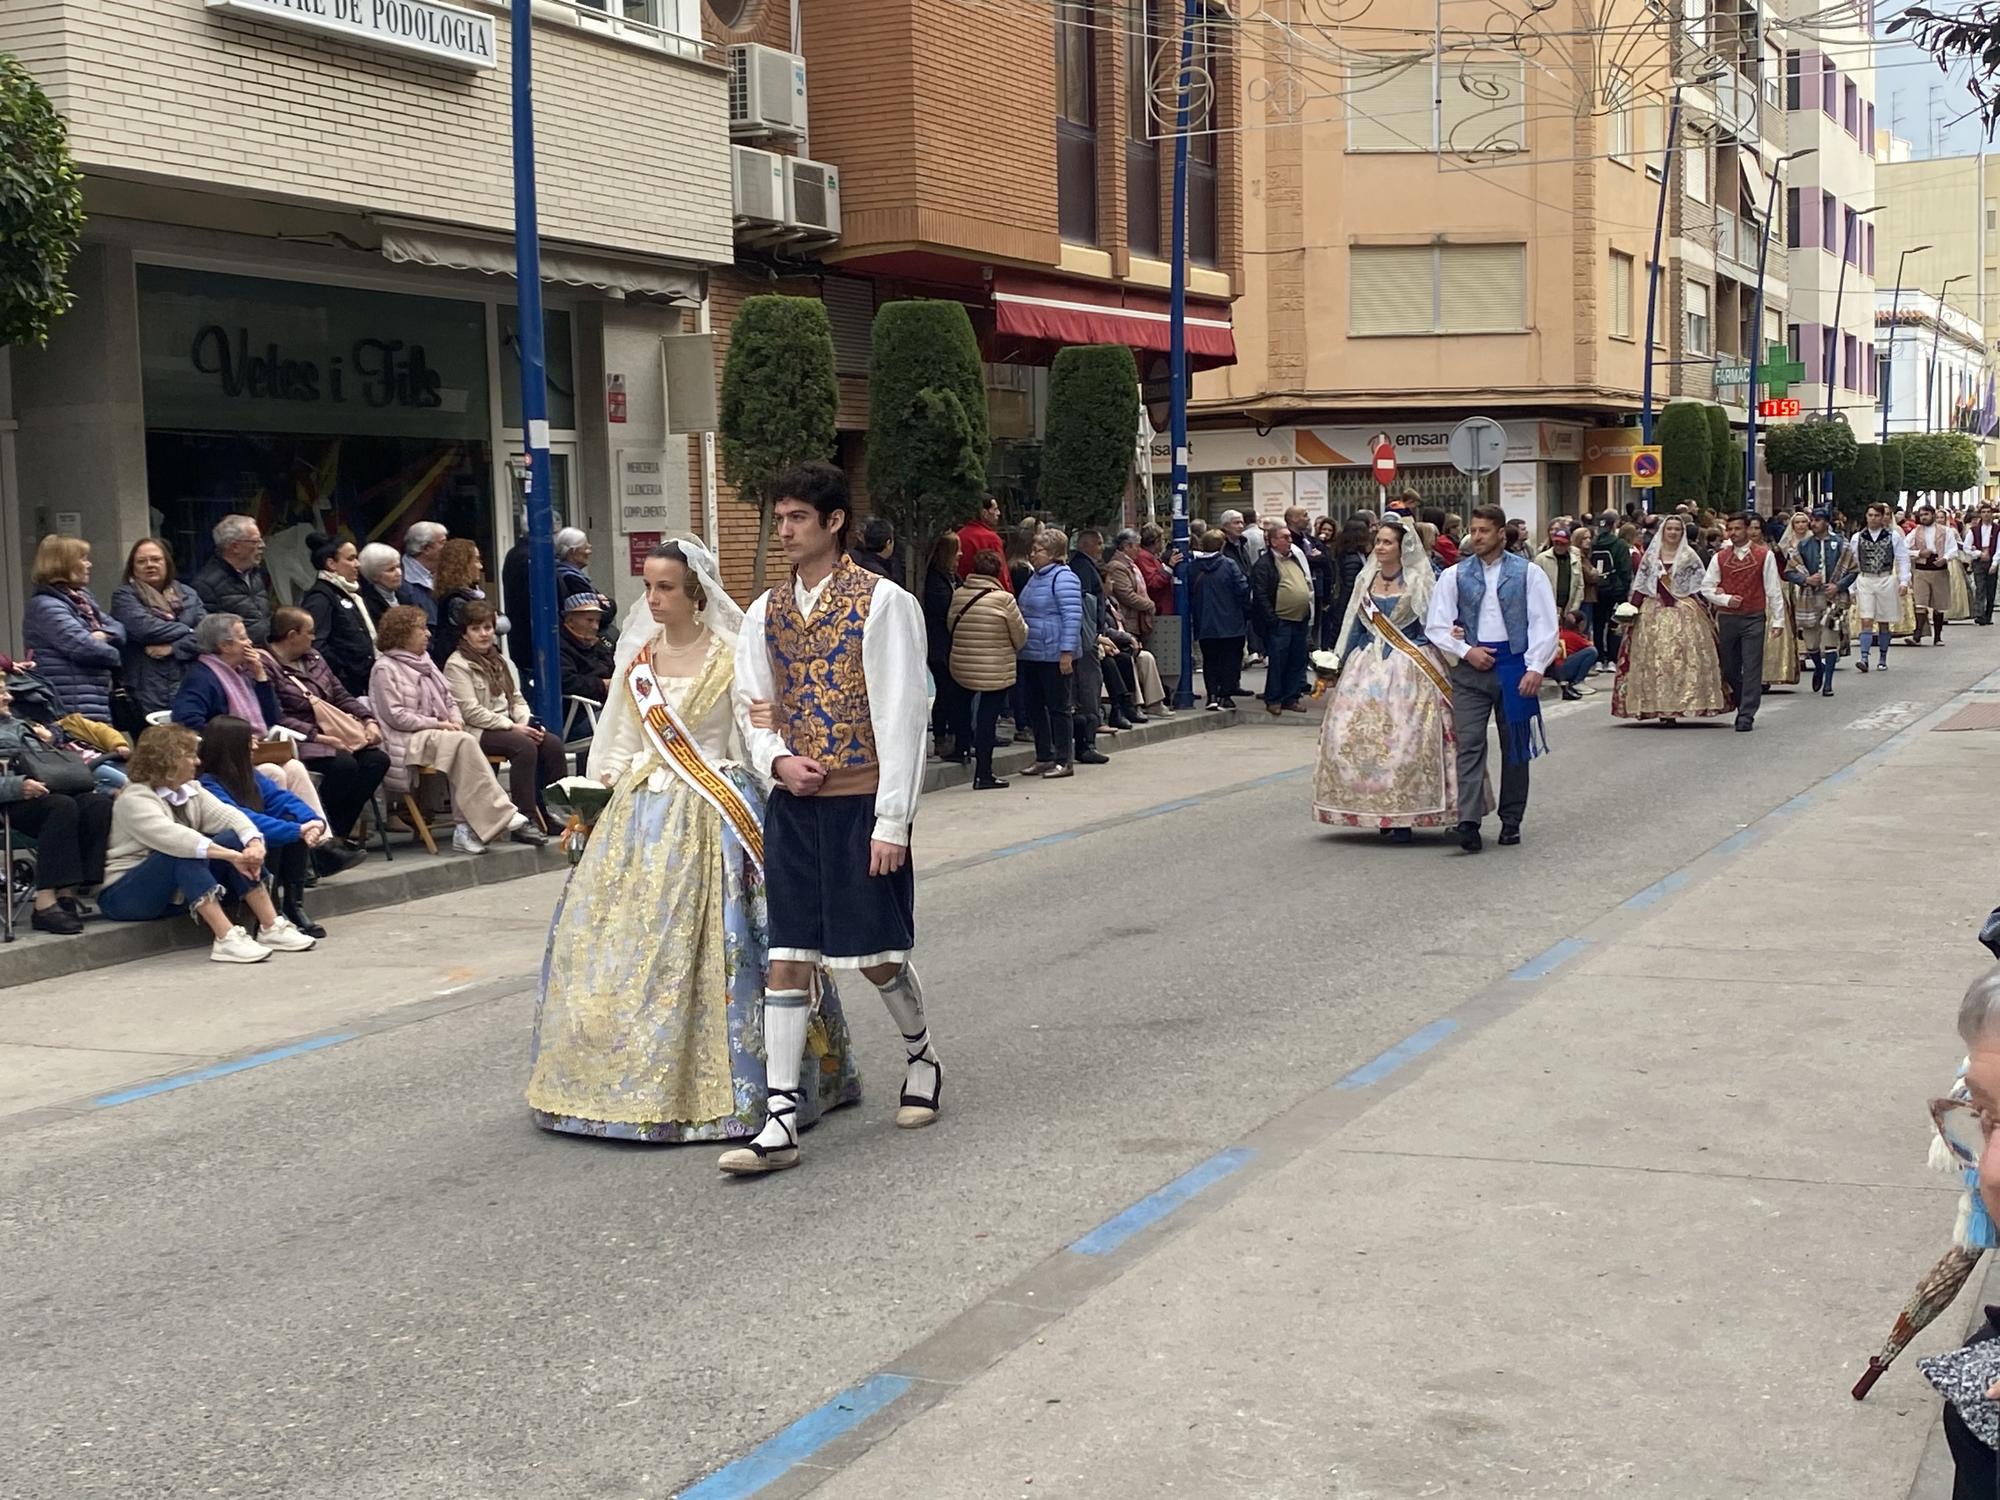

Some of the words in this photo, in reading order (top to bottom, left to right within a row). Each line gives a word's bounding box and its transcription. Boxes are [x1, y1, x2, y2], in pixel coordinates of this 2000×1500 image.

[335, 0, 362, 24] DE
[373, 0, 489, 57] PODOLOGIA
[329, 356, 348, 403] i
[1715, 367, 1751, 384] FARMAC
[1395, 433, 1449, 446] emsan
[623, 506, 668, 518] COMPLEMENTS
